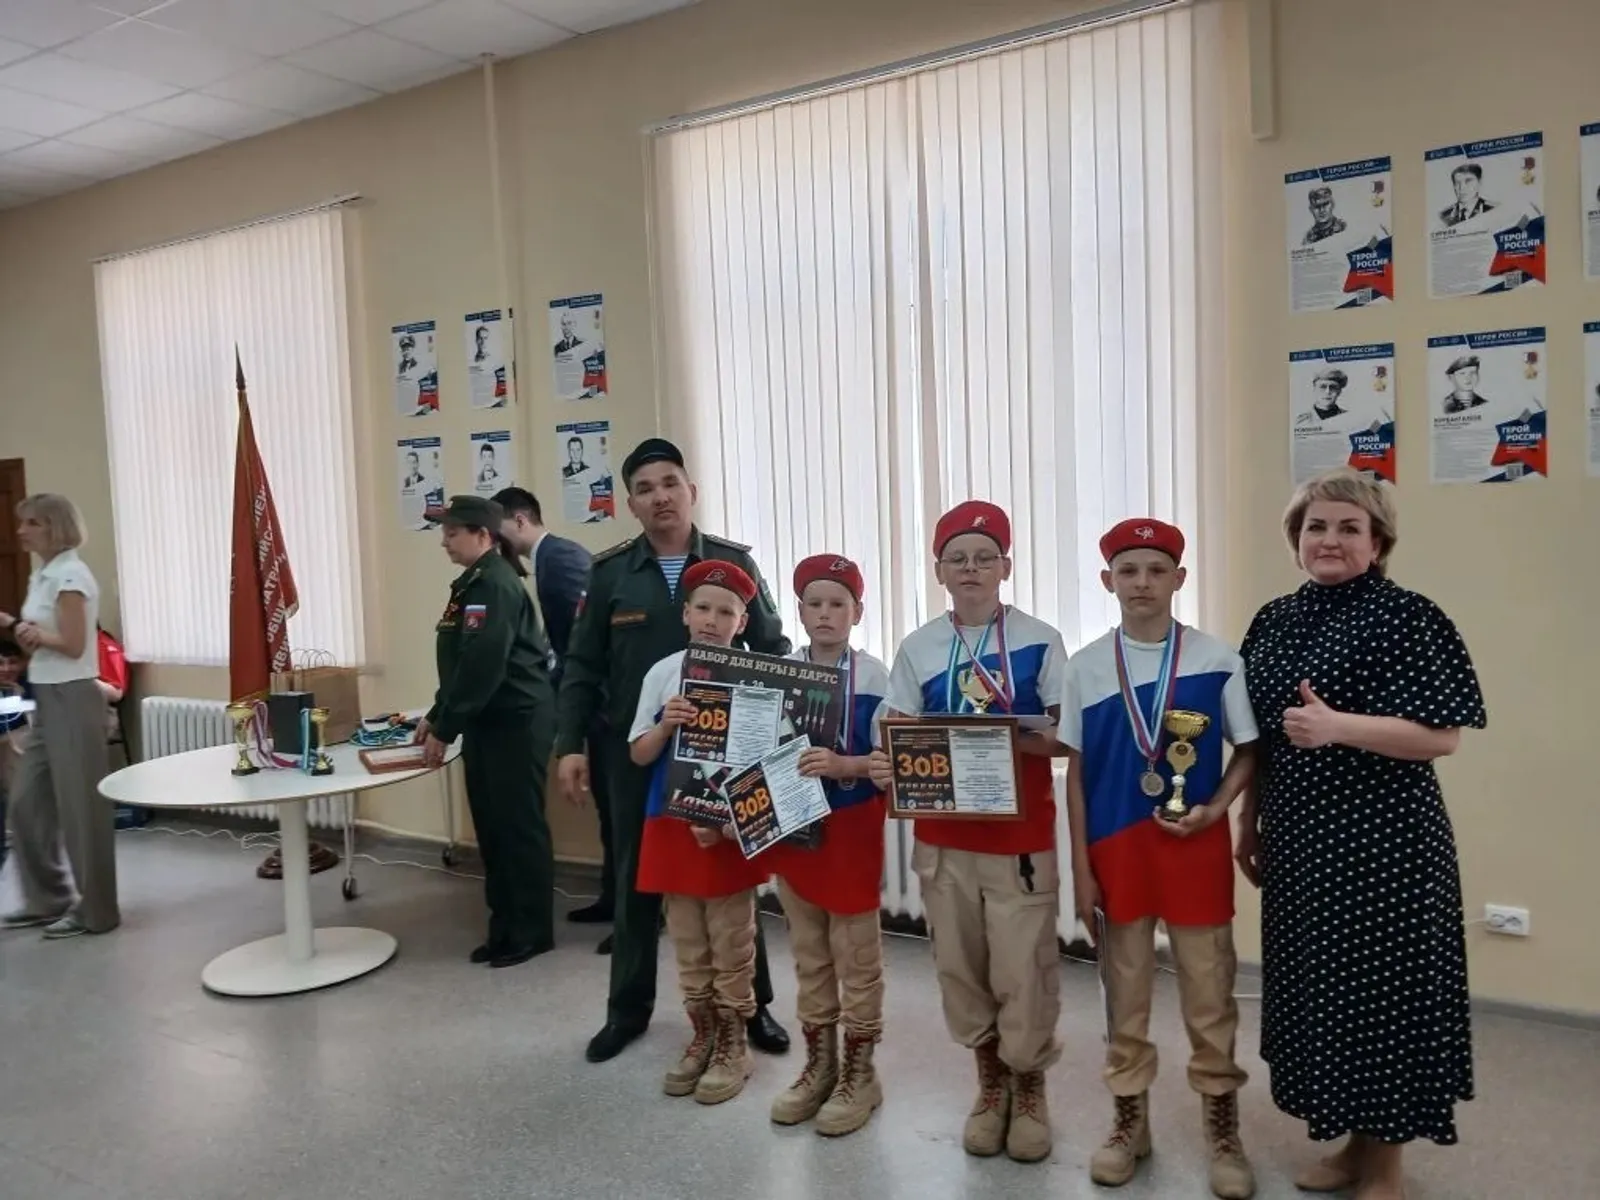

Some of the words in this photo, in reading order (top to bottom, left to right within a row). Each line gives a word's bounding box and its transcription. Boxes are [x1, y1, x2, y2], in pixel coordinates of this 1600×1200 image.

[1504, 238, 1541, 250] РОССИИ
[1505, 432, 1542, 442] РОССИИ
[1358, 442, 1391, 451] РОССИИ
[690, 649, 728, 664] НАБОР
[728, 655, 754, 669] ДЛЯ
[754, 660, 787, 675] ИГРЫ
[788, 666, 798, 677] В
[798, 668, 838, 685] ДАРТС
